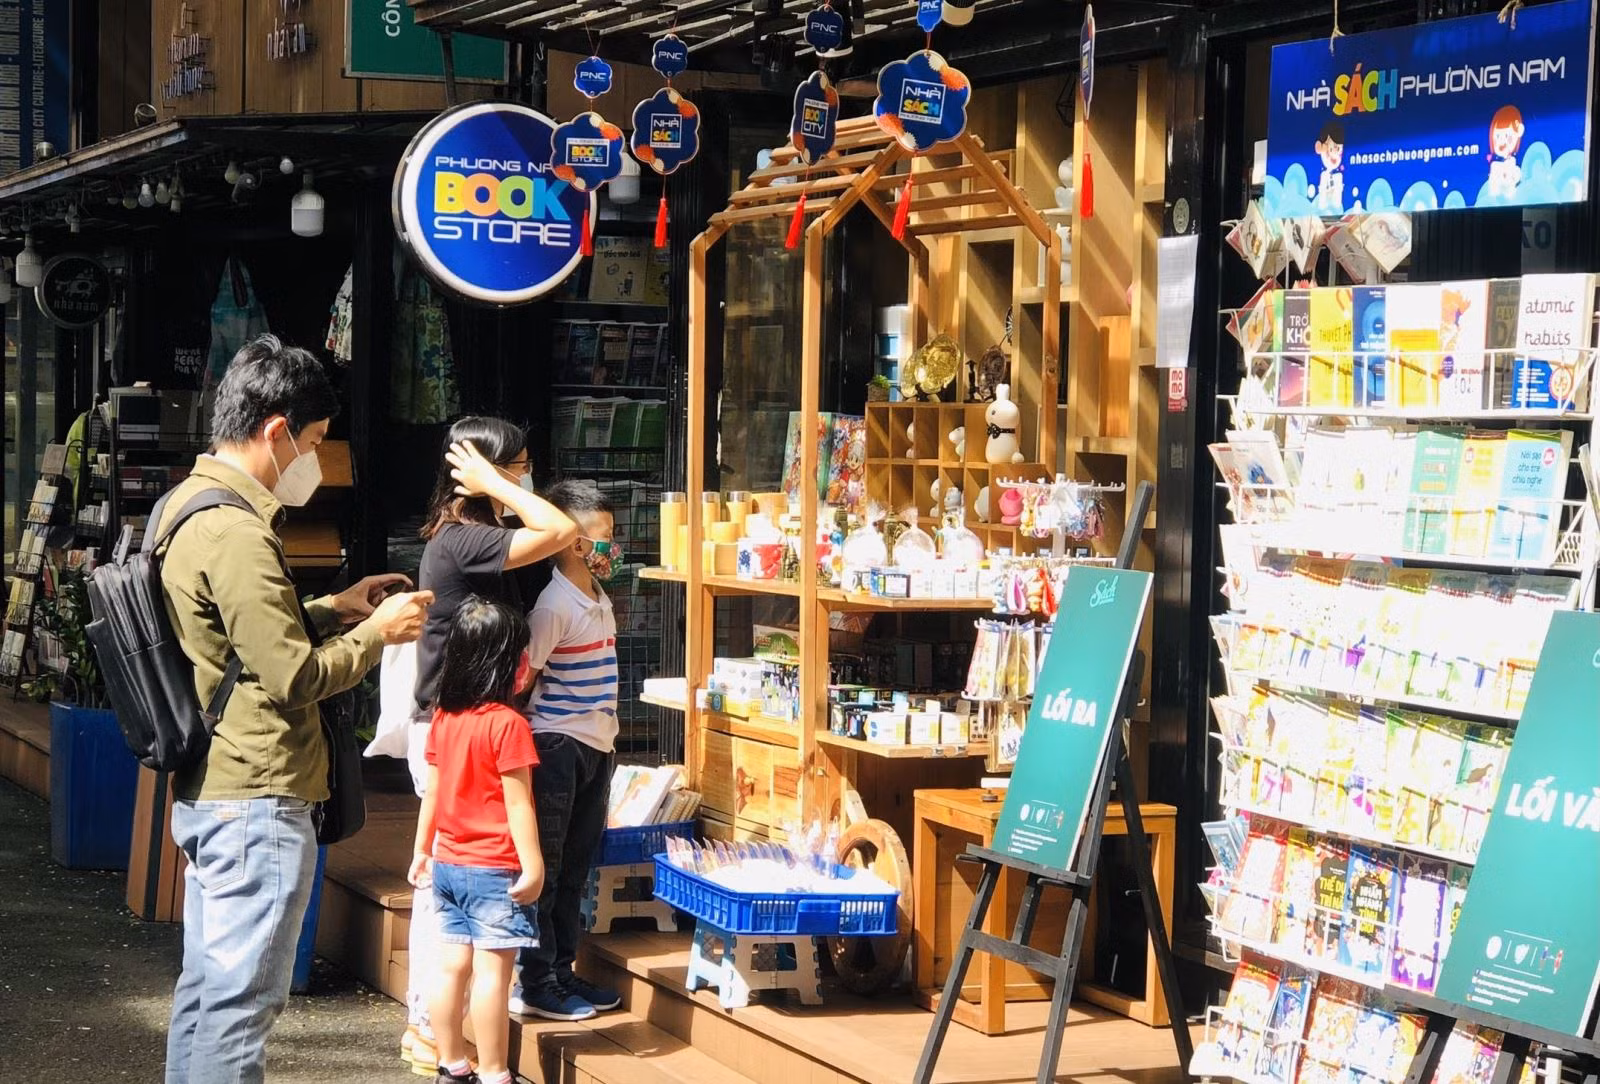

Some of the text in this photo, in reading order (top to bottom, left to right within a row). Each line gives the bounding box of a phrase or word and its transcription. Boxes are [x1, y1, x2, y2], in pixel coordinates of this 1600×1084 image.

[811, 22, 838, 33] PNC
[658, 51, 683, 60] PNC
[580, 71, 607, 80] PNC
[905, 85, 942, 100] NHÀ
[1286, 56, 1566, 116] NHÀ SÁCH PHƯƠNG NAM
[903, 98, 941, 116] SÁCH
[572, 145, 604, 157] BOOK
[1350, 144, 1480, 166] nhasachphuongnam.com
[434, 171, 571, 221] BOOK
[433, 216, 572, 247] STORE
[1525, 296, 1575, 314] atomic
[1525, 328, 1571, 346] habits
[1041, 688, 1097, 727] LỐI RA
[1505, 775, 1558, 822] LỐI
